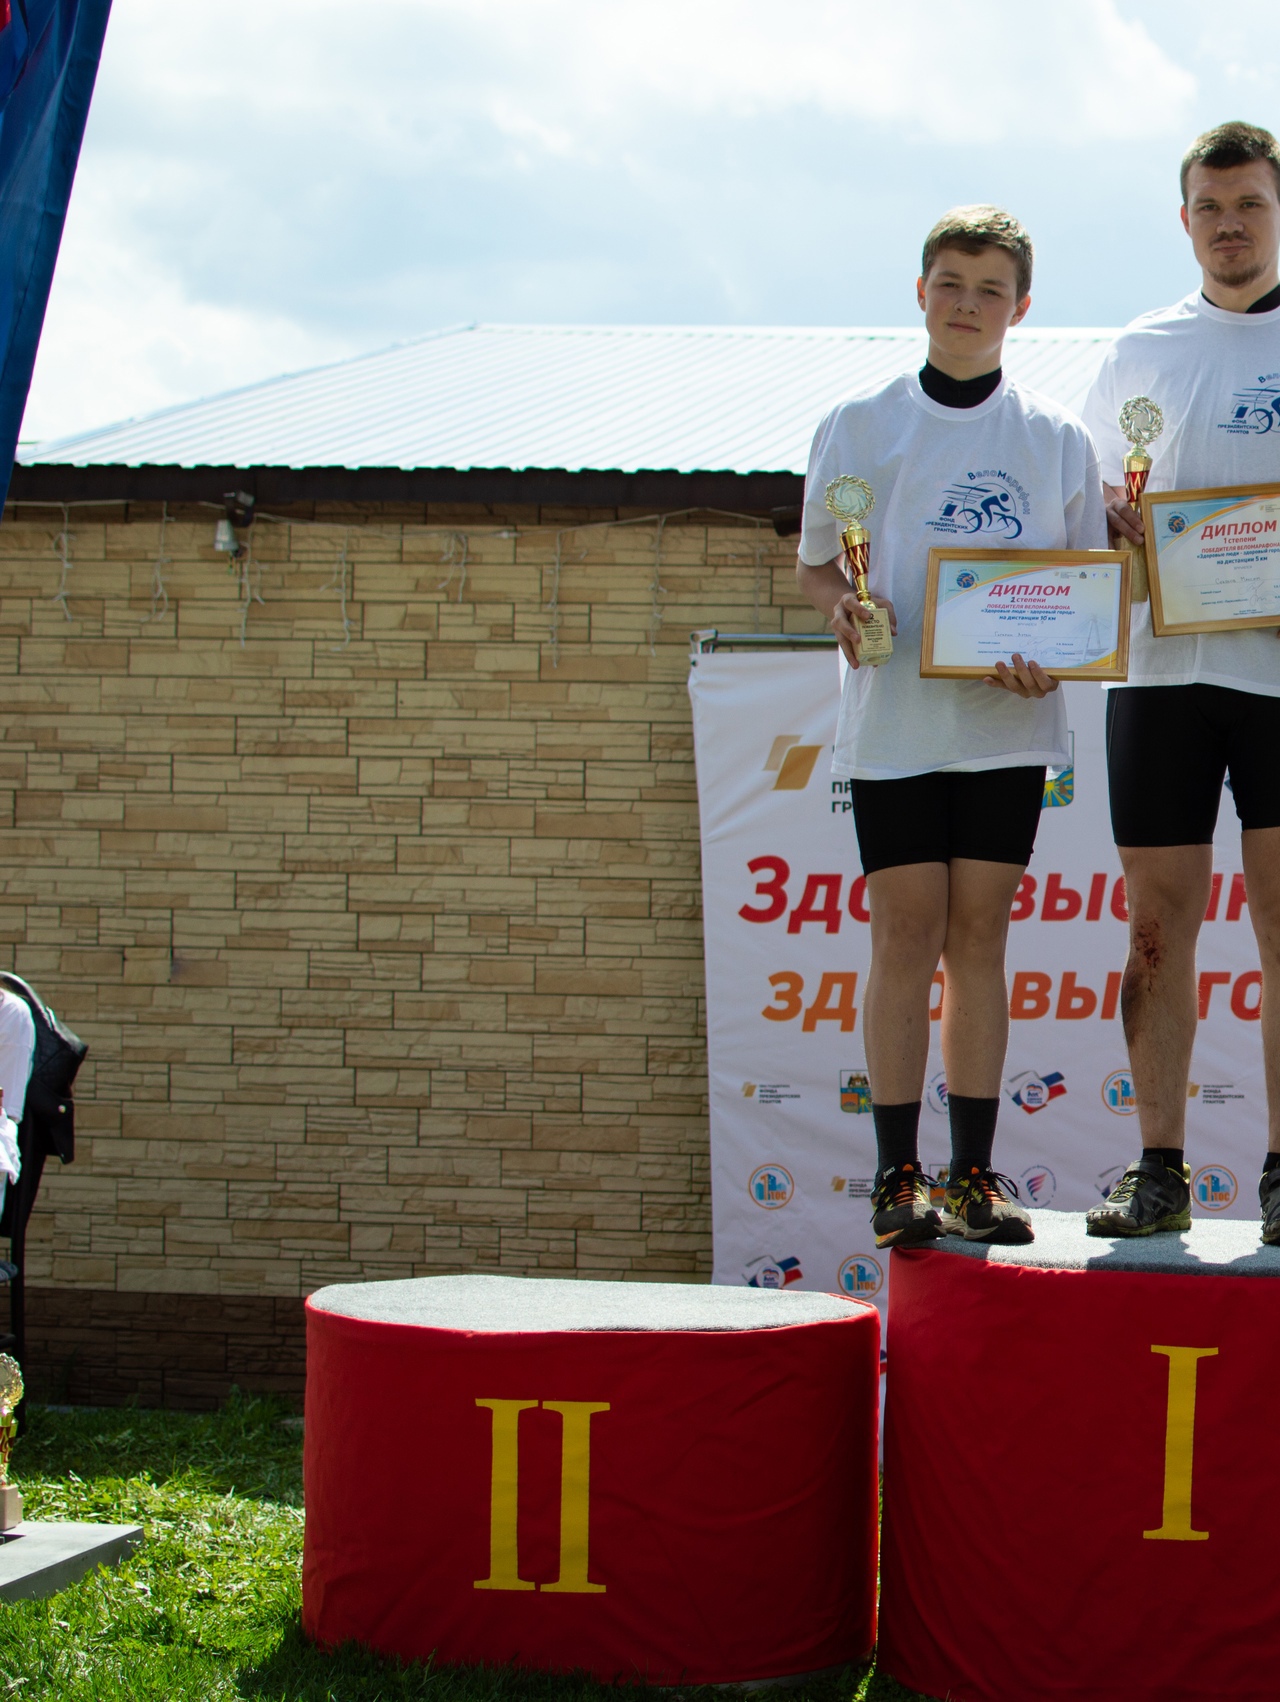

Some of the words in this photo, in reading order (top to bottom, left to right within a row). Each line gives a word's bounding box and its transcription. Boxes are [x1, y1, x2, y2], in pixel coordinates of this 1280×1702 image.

[1201, 520, 1277, 540] ДИПЛОМ
[1237, 542, 1280, 551] ВЕЛОМАРАФОНА
[1224, 557, 1255, 565] дистанции
[988, 584, 1071, 597] ДИПЛОМ
[1143, 1344, 1219, 1541] I
[473, 1398, 610, 1593] II
